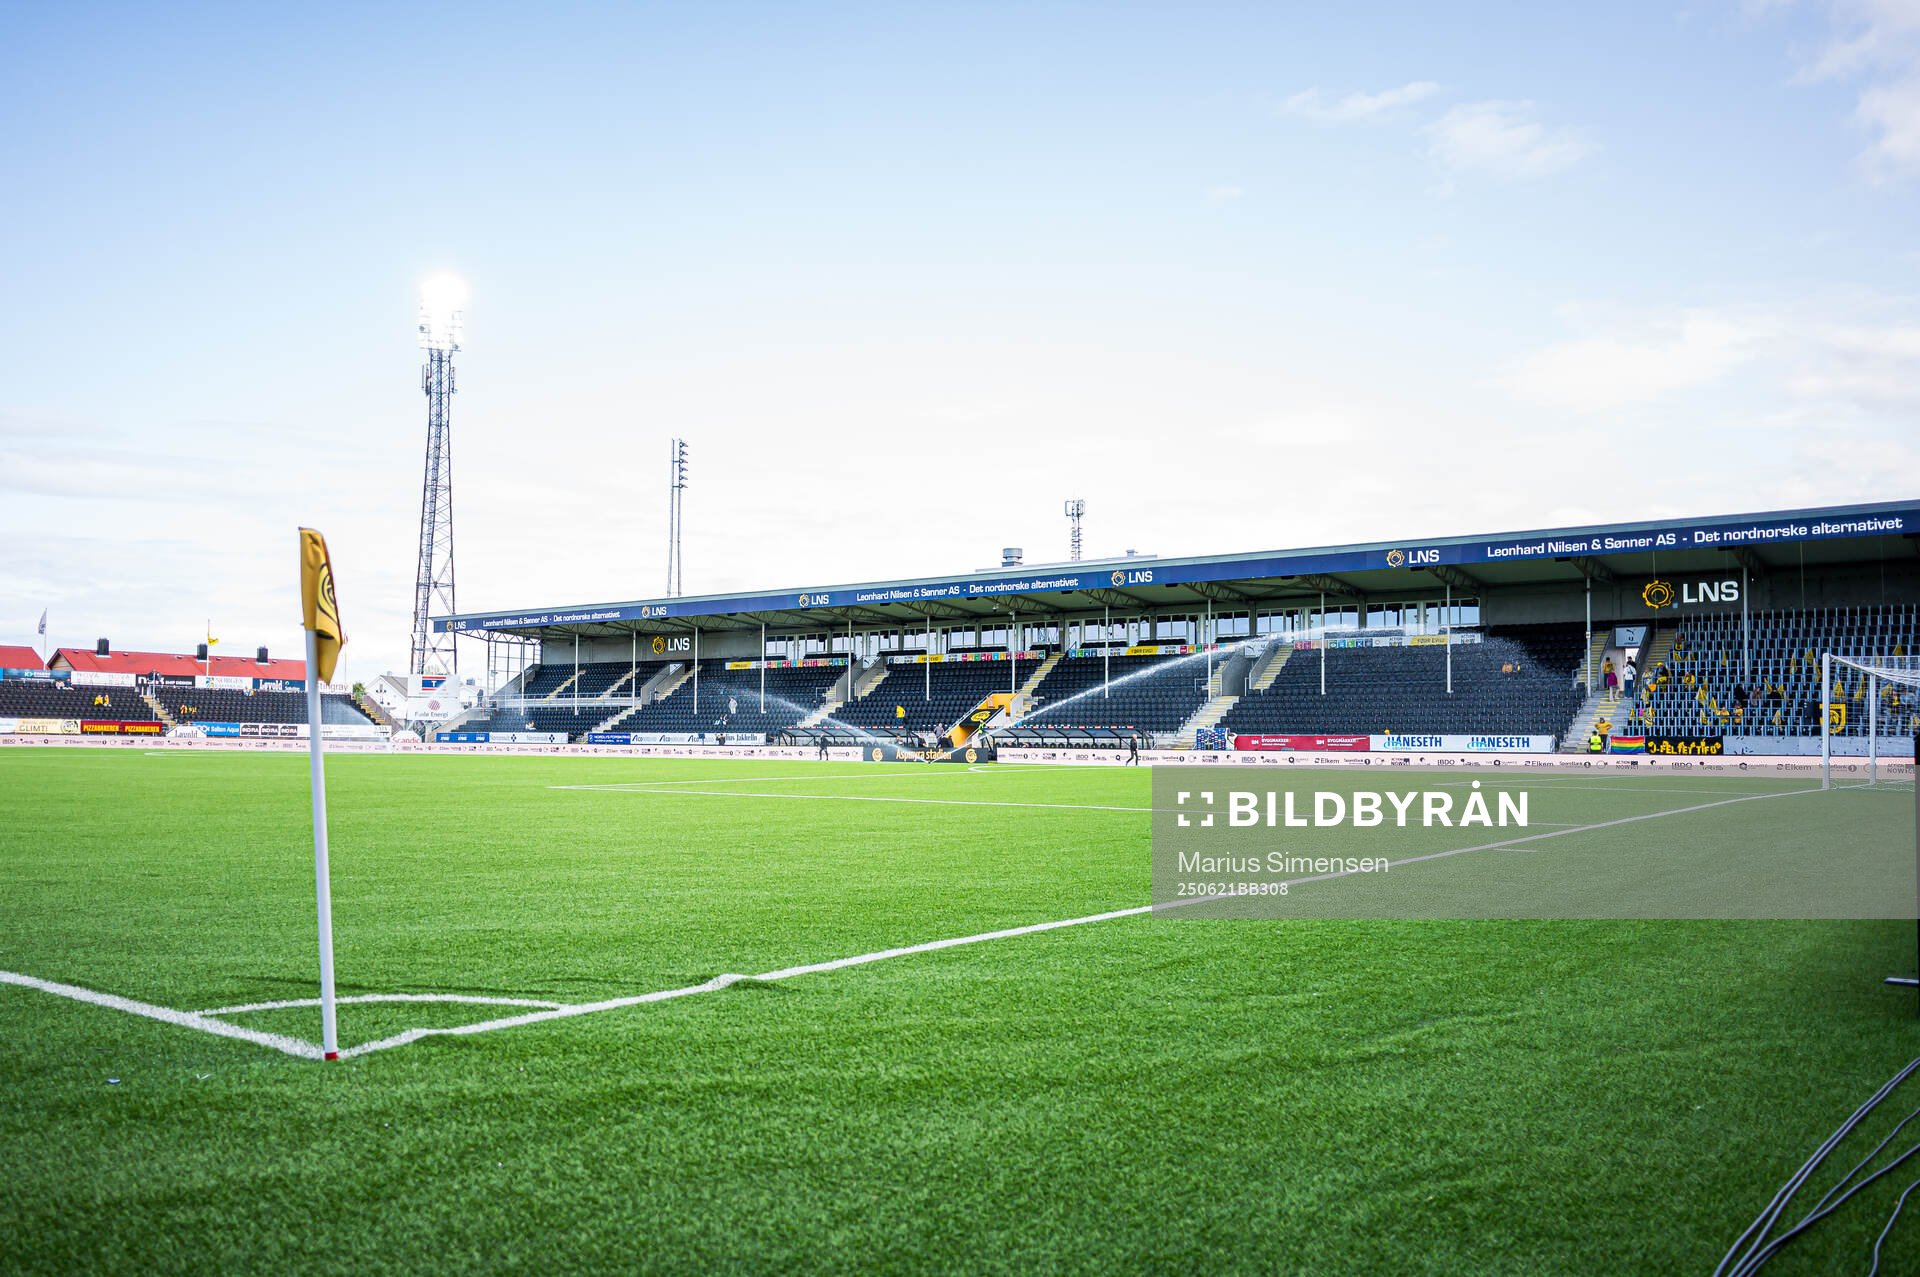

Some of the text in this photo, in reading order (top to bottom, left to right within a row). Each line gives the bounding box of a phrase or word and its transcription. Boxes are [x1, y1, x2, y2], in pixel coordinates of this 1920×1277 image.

[1487, 542, 1545, 558] Leonhard
[1548, 541, 1587, 554] Nilsen
[1591, 539, 1602, 550] &
[1604, 537, 1653, 550] Sønner
[1656, 533, 1676, 546] AS
[1694, 531, 1721, 543] Det
[1723, 524, 1808, 541] nordnorske
[1811, 517, 1903, 535] alternativet
[1408, 550, 1440, 564] LNS
[1128, 570, 1153, 583] LNS
[856, 592, 889, 602] Leonhard
[890, 590, 912, 599] Nilsen
[913, 589, 920, 598] &
[920, 588, 947, 597] Sønner
[948, 586, 960, 595] AS
[969, 584, 984, 594] Det
[985, 581, 1030, 593] nordnorske
[1030, 577, 1079, 589] alternativet
[1682, 580, 1739, 604] LNS
[811, 594, 829, 605] LNS
[651, 606, 667, 616] LNS
[454, 621, 467, 630] LNS
[483, 619, 504, 627] Leonhard
[553, 614, 563, 622] Det
[668, 637, 690, 651] LNS
[317, 683, 348, 693] tingray
[1386, 736, 1442, 748] HANESETH
[1470, 736, 1530, 748] HANESETH
